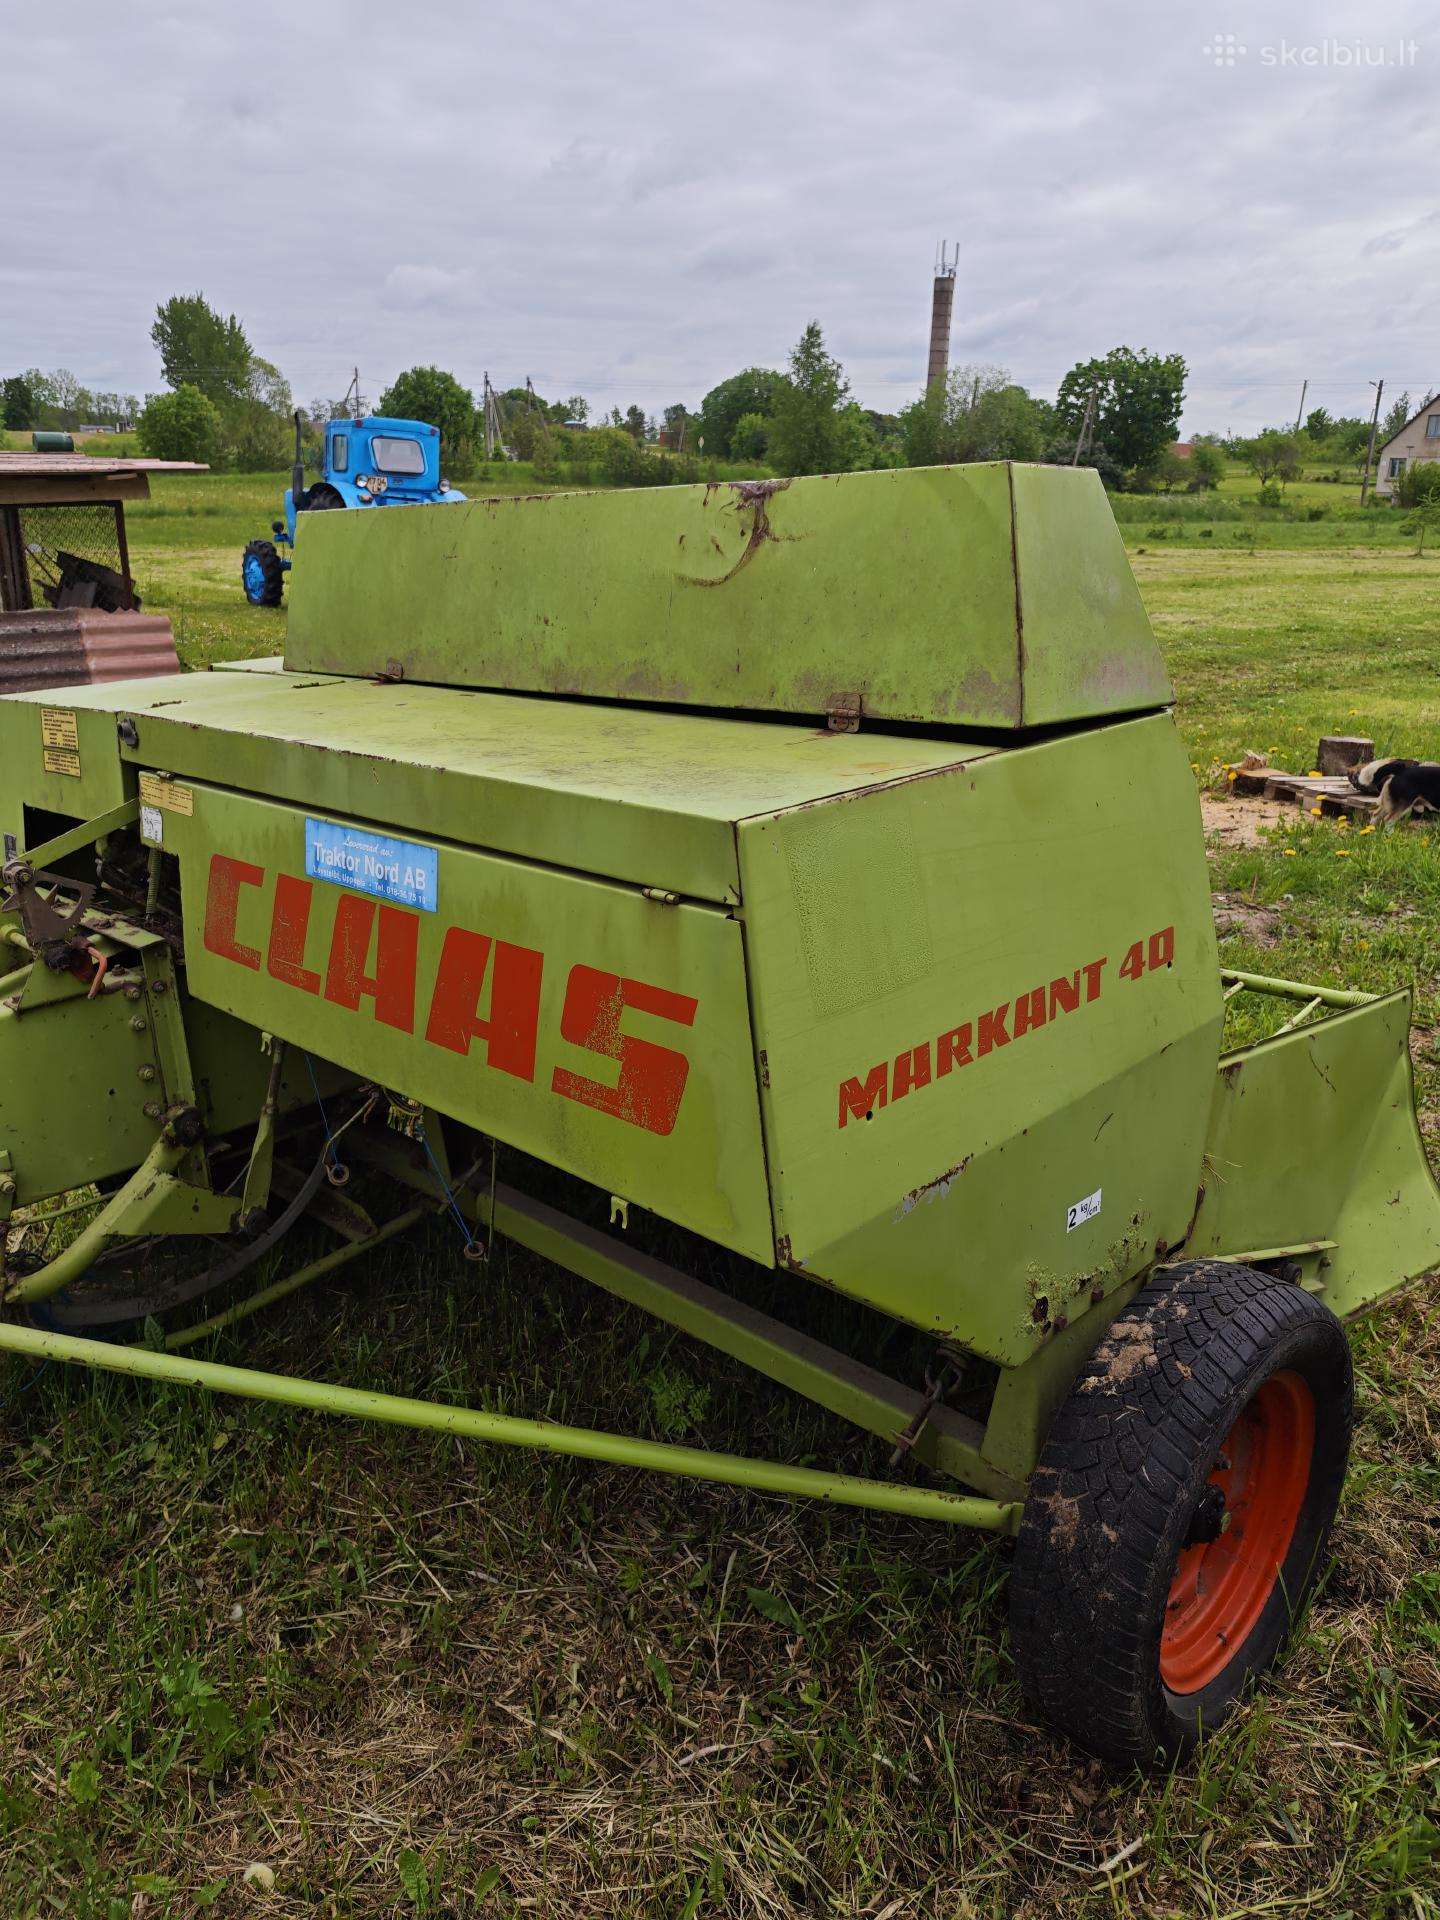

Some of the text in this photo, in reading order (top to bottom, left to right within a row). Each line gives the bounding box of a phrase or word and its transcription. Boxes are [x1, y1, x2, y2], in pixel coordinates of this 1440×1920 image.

[313, 842, 426, 891] Traktor Nord AB
[204, 853, 698, 1136] CLAAS
[838, 926, 1174, 1129] MARKANT 40
[1069, 1208, 1077, 1229] 2
